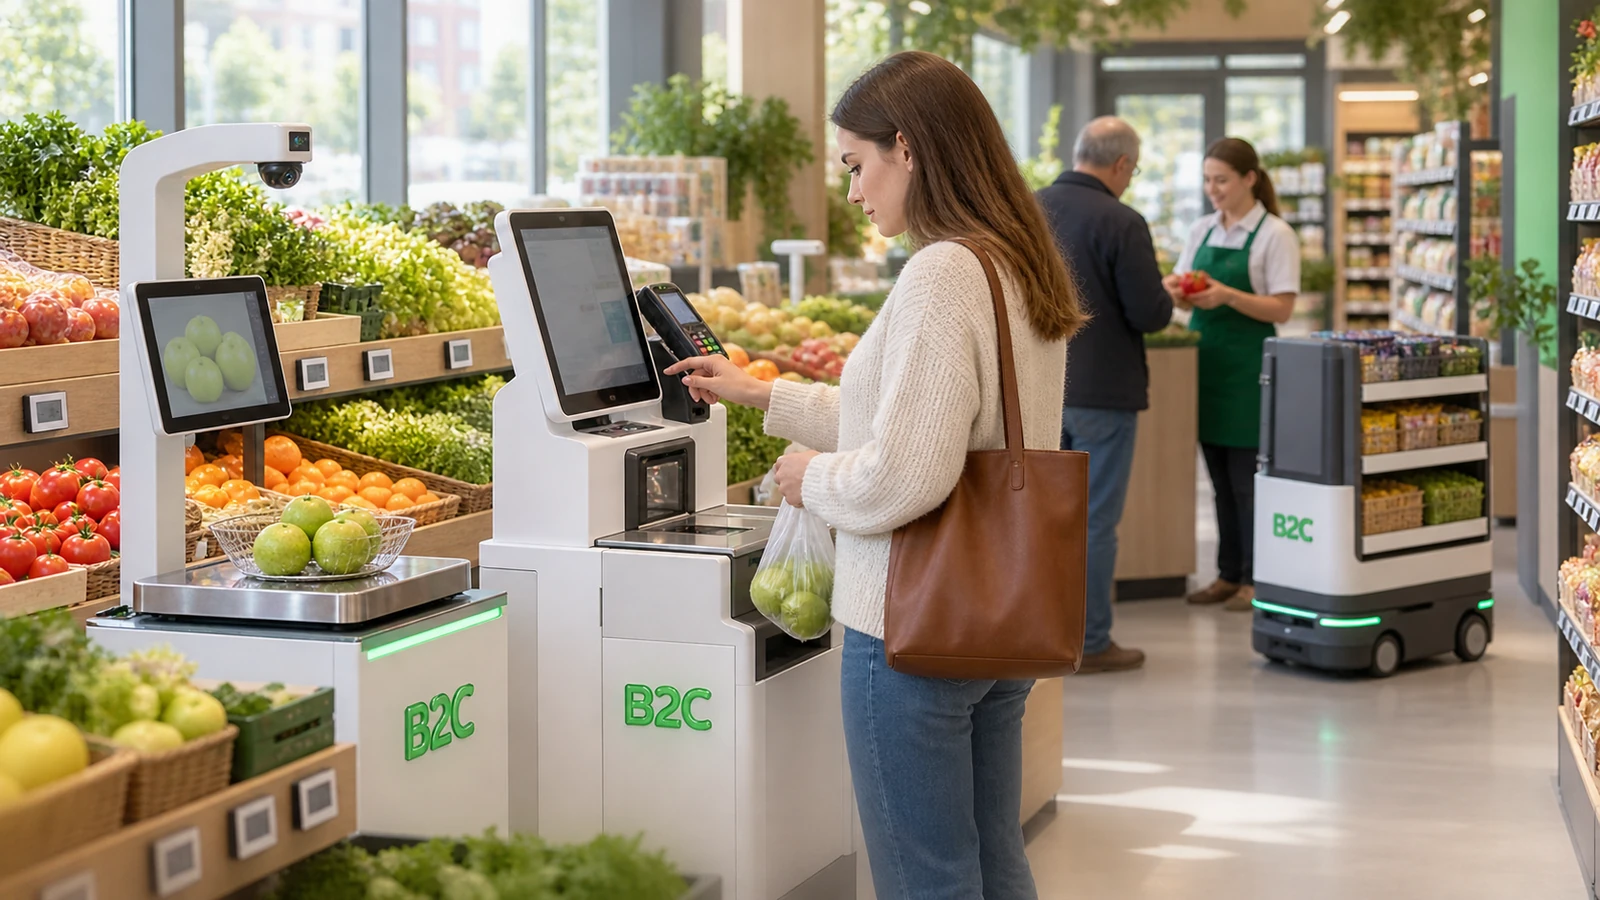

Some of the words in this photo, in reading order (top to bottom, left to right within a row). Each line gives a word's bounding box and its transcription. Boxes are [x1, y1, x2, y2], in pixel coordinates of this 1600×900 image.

[1273, 512, 1313, 543] B2C
[404, 683, 475, 761] B2C
[624, 683, 712, 731] B2C
